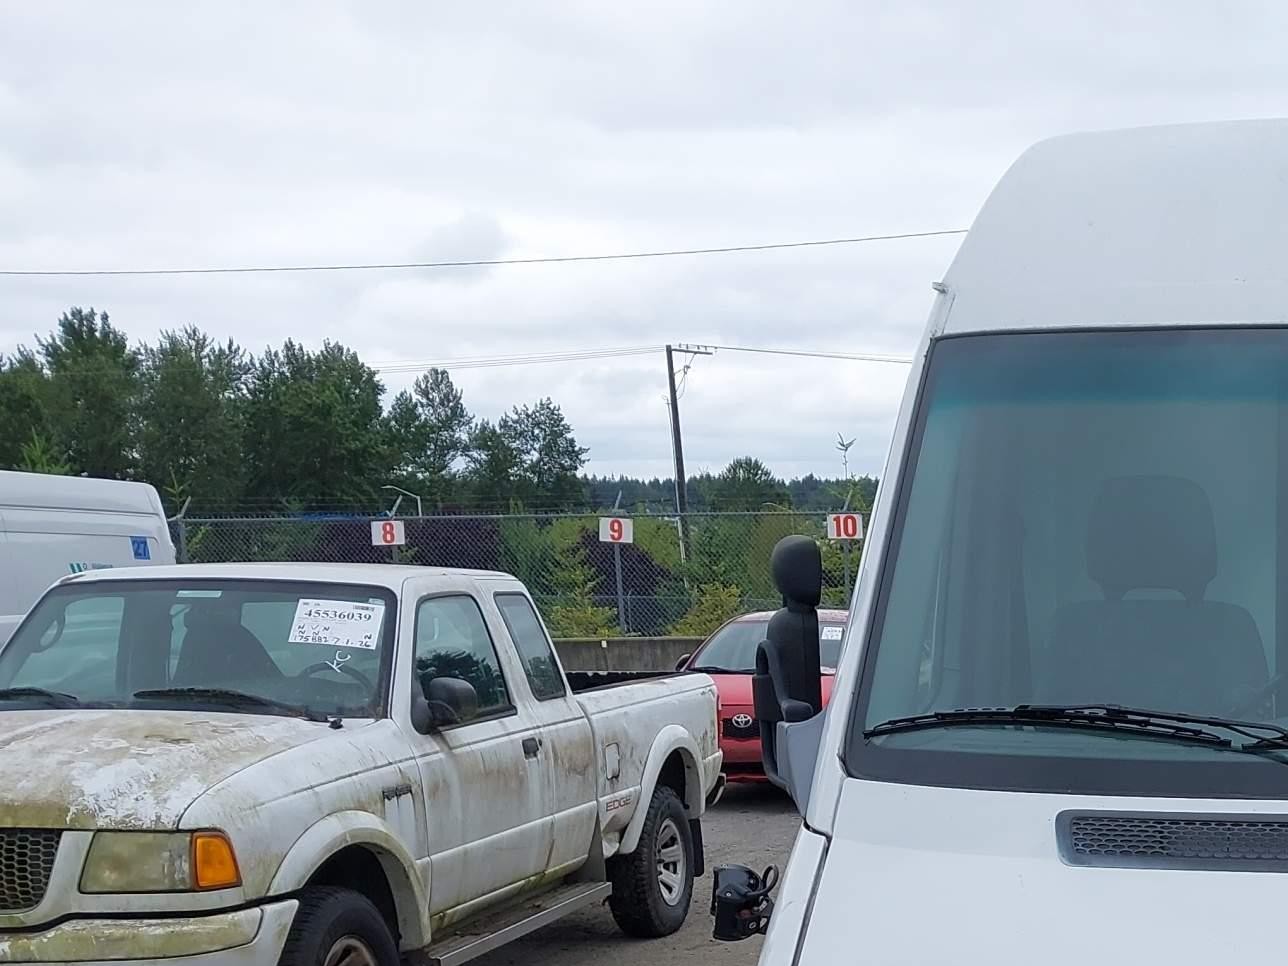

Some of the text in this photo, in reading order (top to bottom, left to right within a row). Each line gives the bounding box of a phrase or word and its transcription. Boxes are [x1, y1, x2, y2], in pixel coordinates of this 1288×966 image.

[381, 521, 395, 544] 8
[609, 518, 623, 541] 9
[833, 515, 857, 538] 10
[304, 609, 372, 621] 45536039
[606, 795, 632, 812] EDGE
